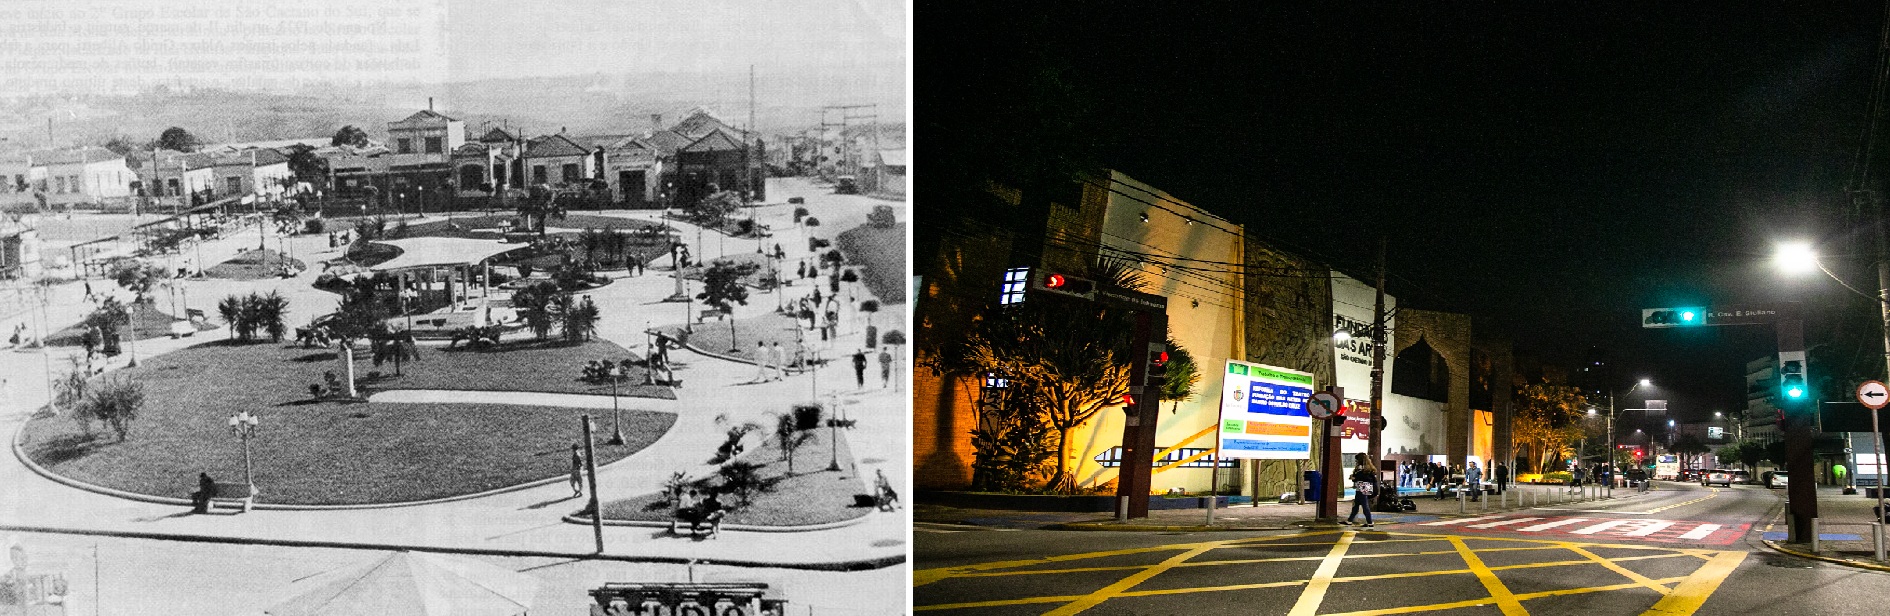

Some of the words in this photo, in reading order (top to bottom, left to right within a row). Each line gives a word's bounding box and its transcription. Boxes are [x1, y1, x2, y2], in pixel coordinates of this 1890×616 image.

[112, 6, 154, 22] Grupo
[160, 6, 209, 19] Escolar
[235, 5, 260, 18] São
[266, 5, 319, 18] Caetano
[324, 5, 341, 18] do
